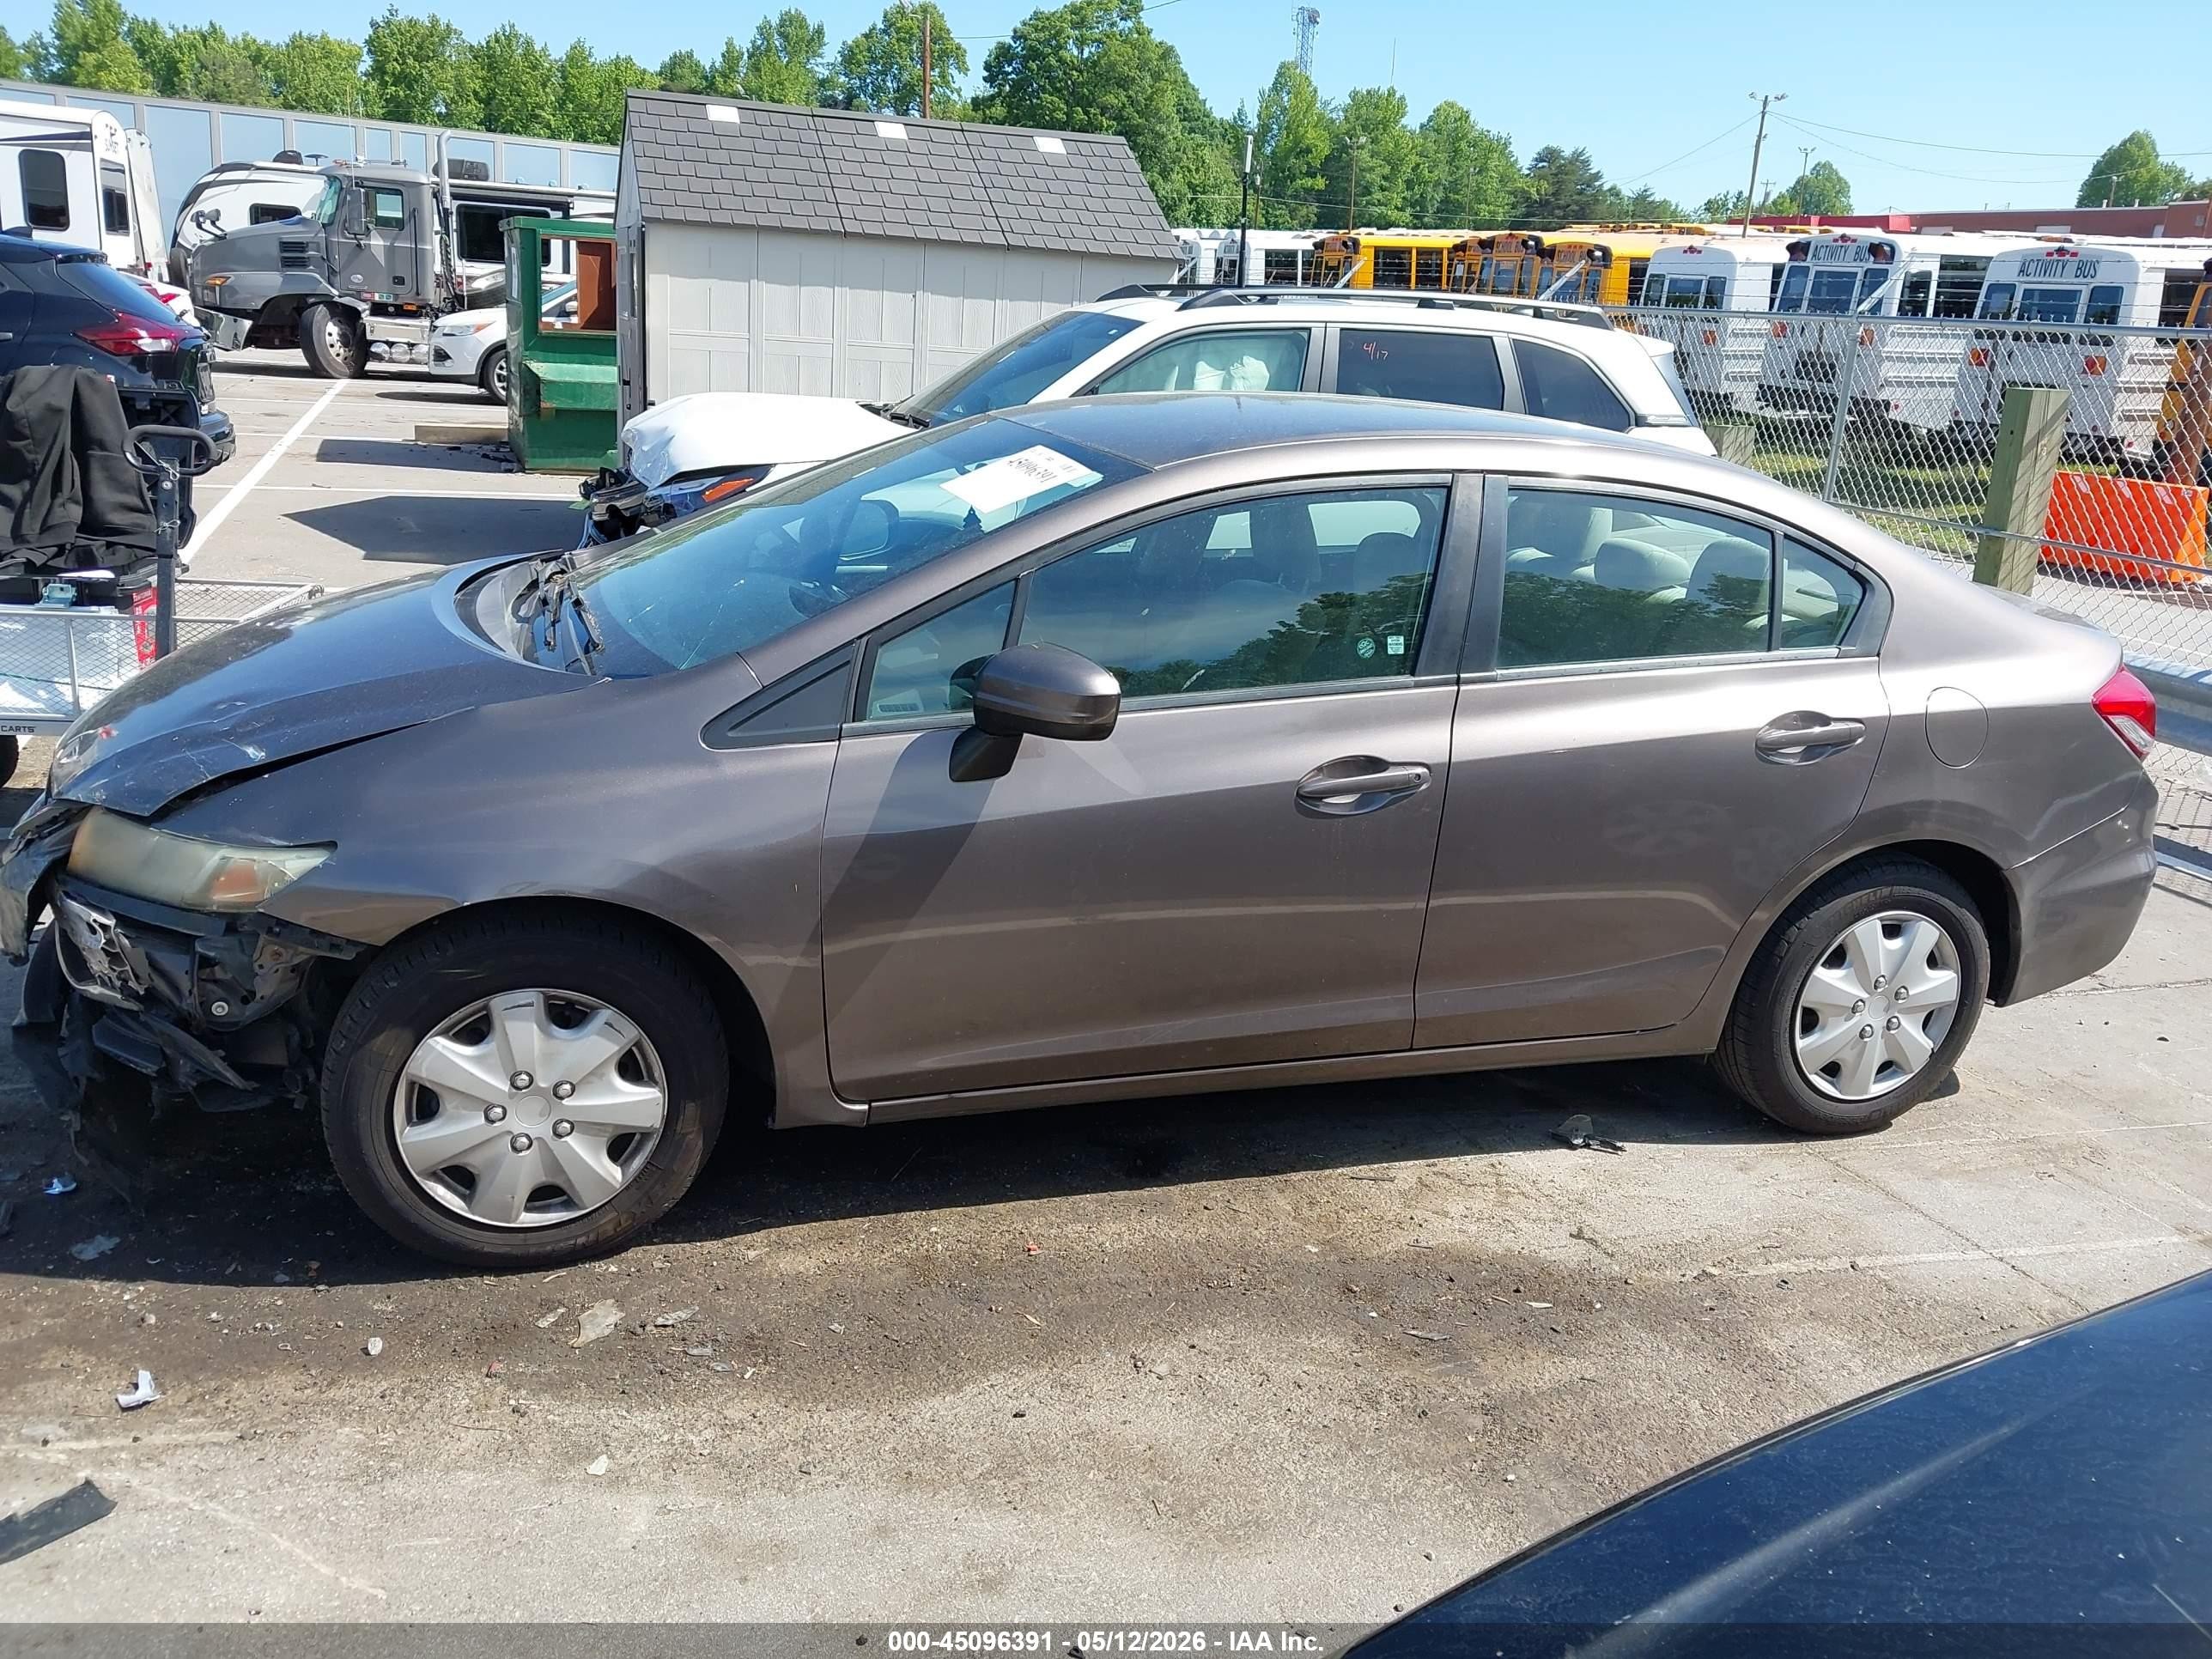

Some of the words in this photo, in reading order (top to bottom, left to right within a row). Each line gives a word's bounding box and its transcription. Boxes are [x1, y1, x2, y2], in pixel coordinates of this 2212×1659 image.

[1811, 244, 1850, 261] ACTIVITY
[1853, 246, 1870, 262] BUS
[2017, 258, 2069, 276] ACTIVITY
[2074, 259, 2100, 278] BUS
[1363, 342, 1389, 361] 4/17
[0, 725, 35, 733] CARTS
